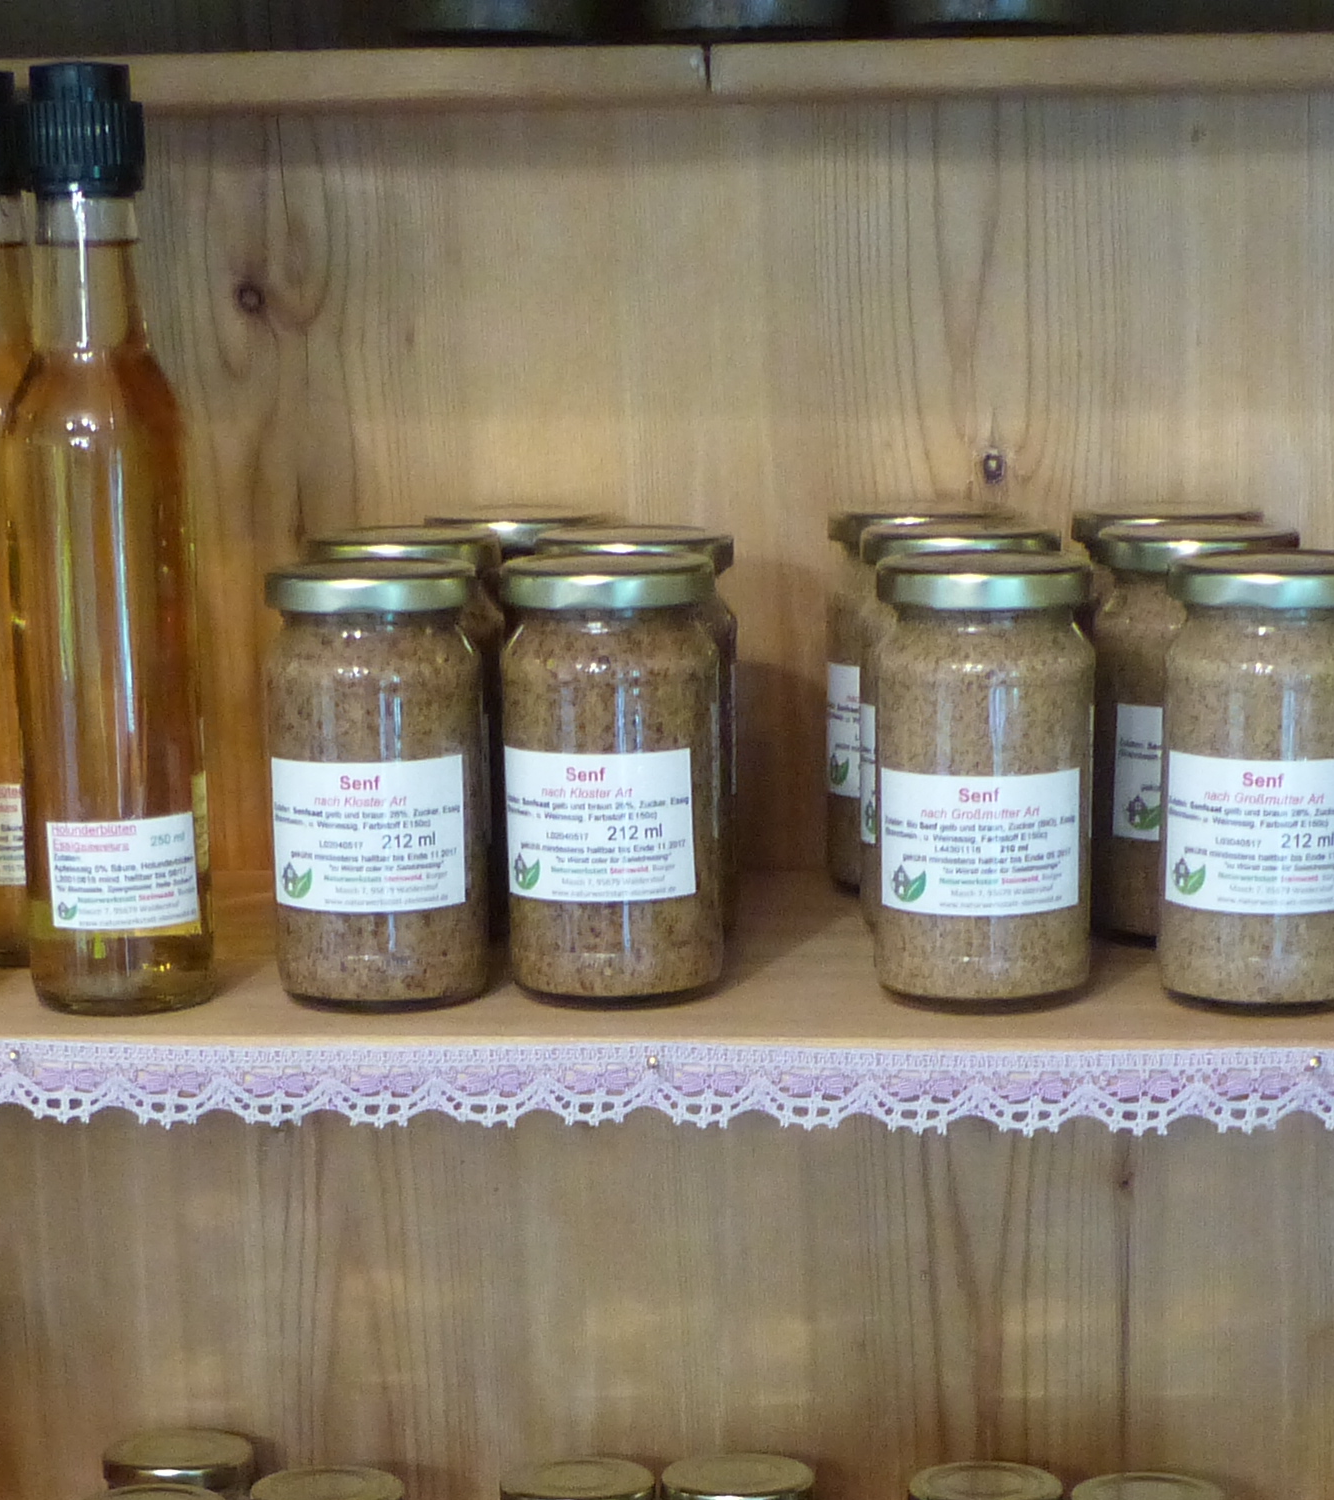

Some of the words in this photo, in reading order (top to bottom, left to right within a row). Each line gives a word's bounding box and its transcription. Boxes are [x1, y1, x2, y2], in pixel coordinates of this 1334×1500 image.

[566, 767, 606, 782] Senf
[1243, 772, 1284, 788] Senf
[340, 775, 381, 790] Senf
[542, 788, 566, 797] nach
[570, 788, 611, 798] Kloster
[615, 788, 633, 797] Art
[959, 788, 999, 802] Senf
[1205, 790, 1229, 801] nach
[1235, 792, 1304, 805] Großmutter
[1308, 794, 1324, 804] Art
[314, 798, 340, 807] nach
[344, 797, 385, 807] Kloster
[390, 796, 407, 806] Art
[570, 801, 585, 809] und
[345, 810, 359, 818] und
[922, 808, 947, 819] nach
[952, 807, 1020, 820] Großmutter
[1024, 807, 1040, 817] Art
[1244, 808, 1260, 816] und
[608, 827, 638, 840] 212
[645, 824, 662, 837] ml
[959, 823, 975, 831] und
[151, 835, 170, 846] 250
[174, 833, 185, 842] ml
[382, 834, 412, 849] 212
[419, 832, 436, 846] ml
[1281, 833, 1311, 848] 212
[1317, 832, 1334, 847] ml
